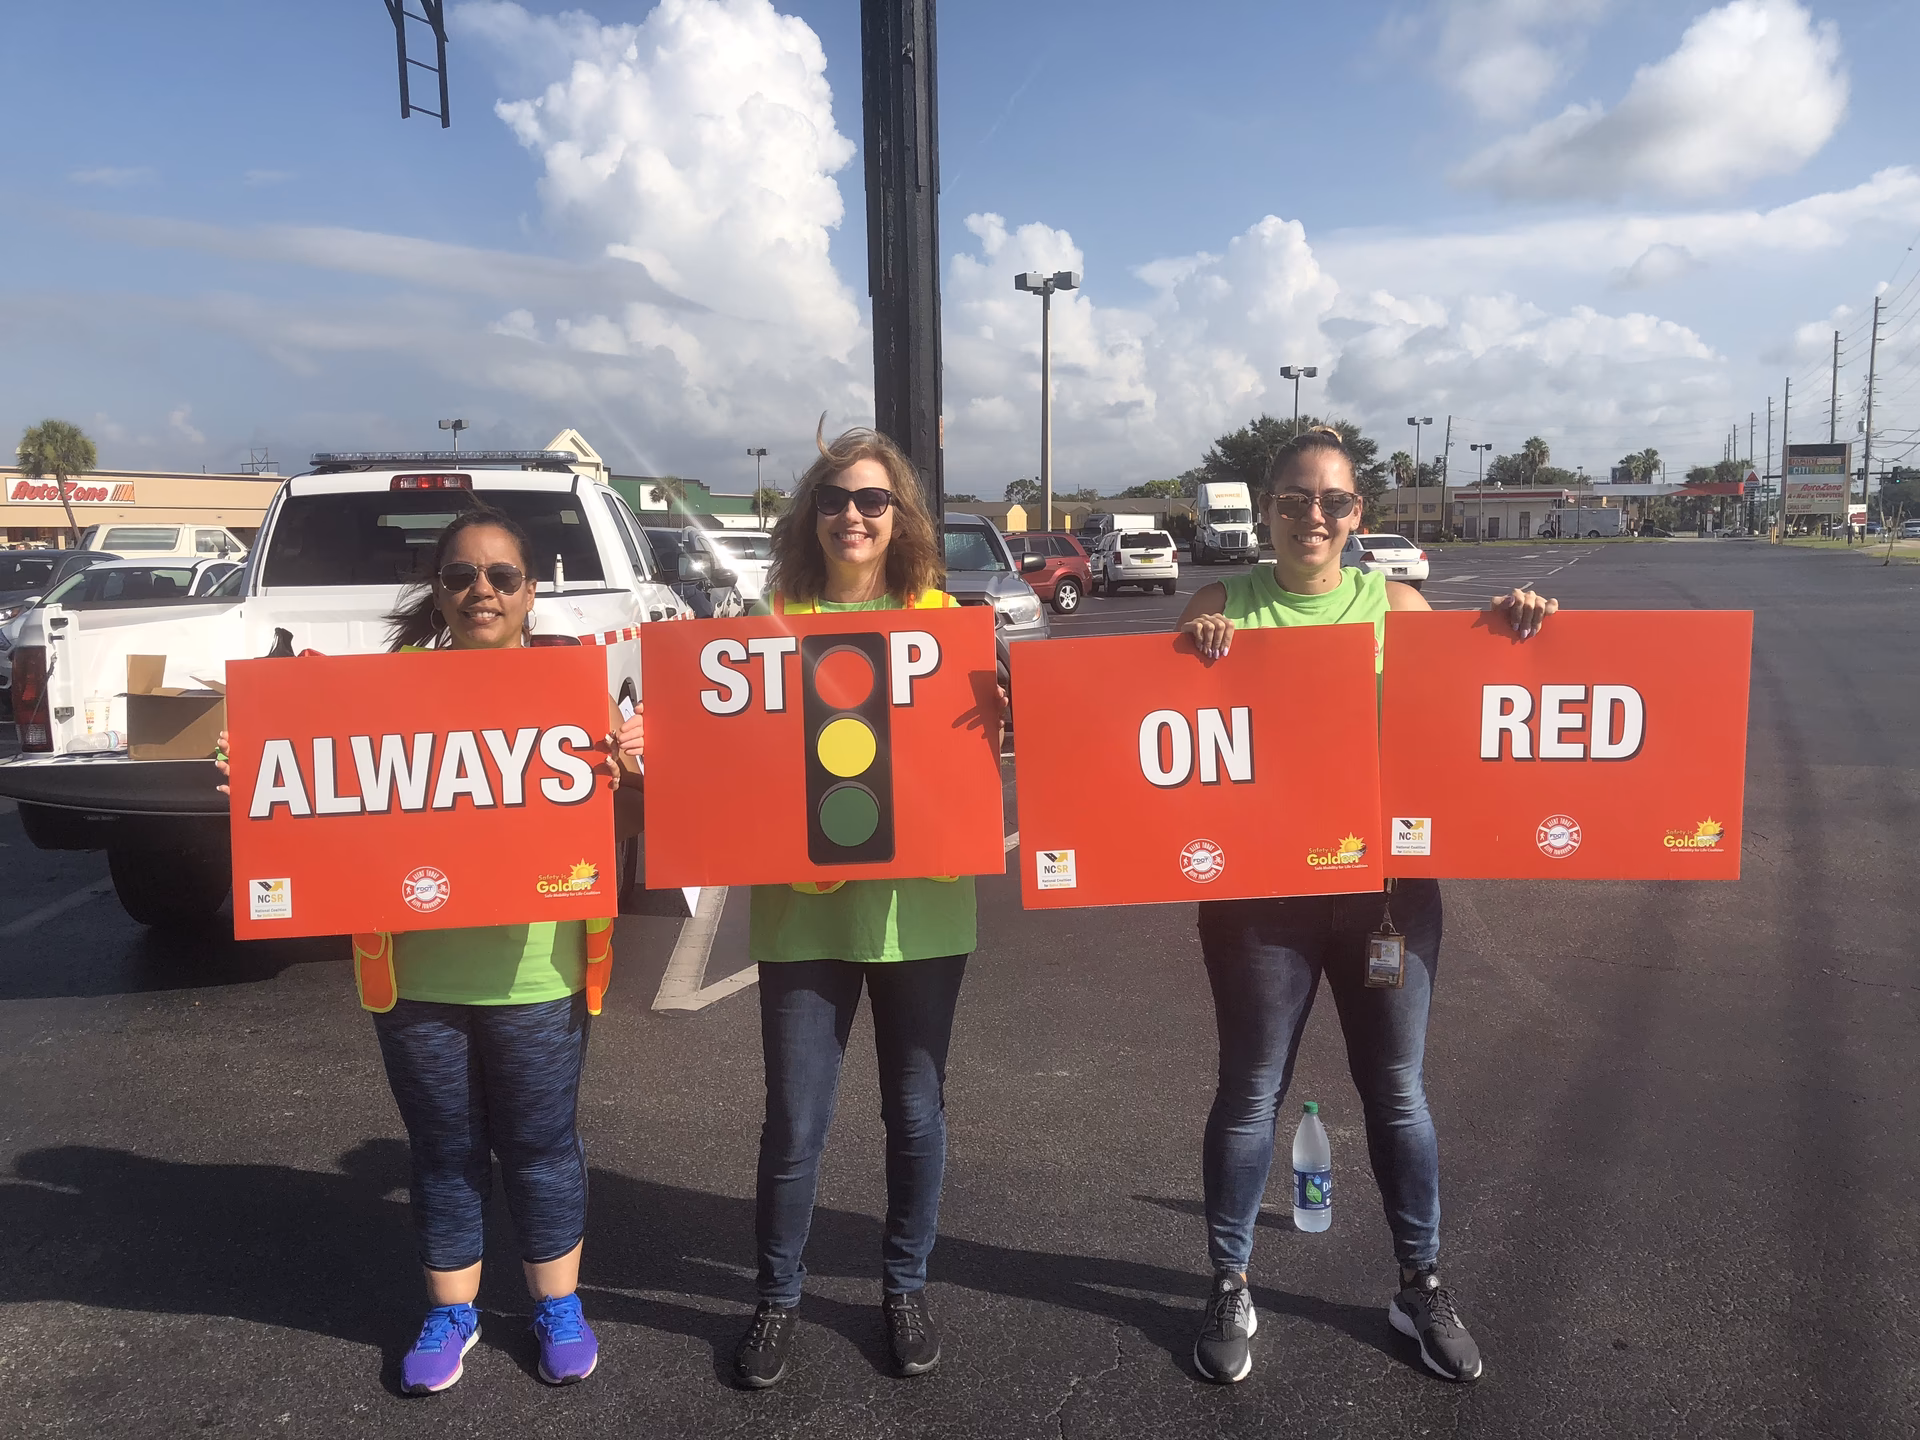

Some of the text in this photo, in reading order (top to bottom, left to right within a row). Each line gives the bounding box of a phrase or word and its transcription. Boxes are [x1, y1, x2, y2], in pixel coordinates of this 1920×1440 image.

[11, 481, 109, 502] AutoZone
[1480, 684, 1646, 763] RED
[1138, 706, 1256, 788] ON
[249, 724, 596, 820] ALWAYS
[1398, 832, 1424, 841] NCSR
[1663, 834, 1717, 848] Golden
[1306, 852, 1359, 866] Golden
[1043, 865, 1069, 874] NCSR
[536, 879, 592, 894] Golden
[257, 893, 284, 904] NCSR
